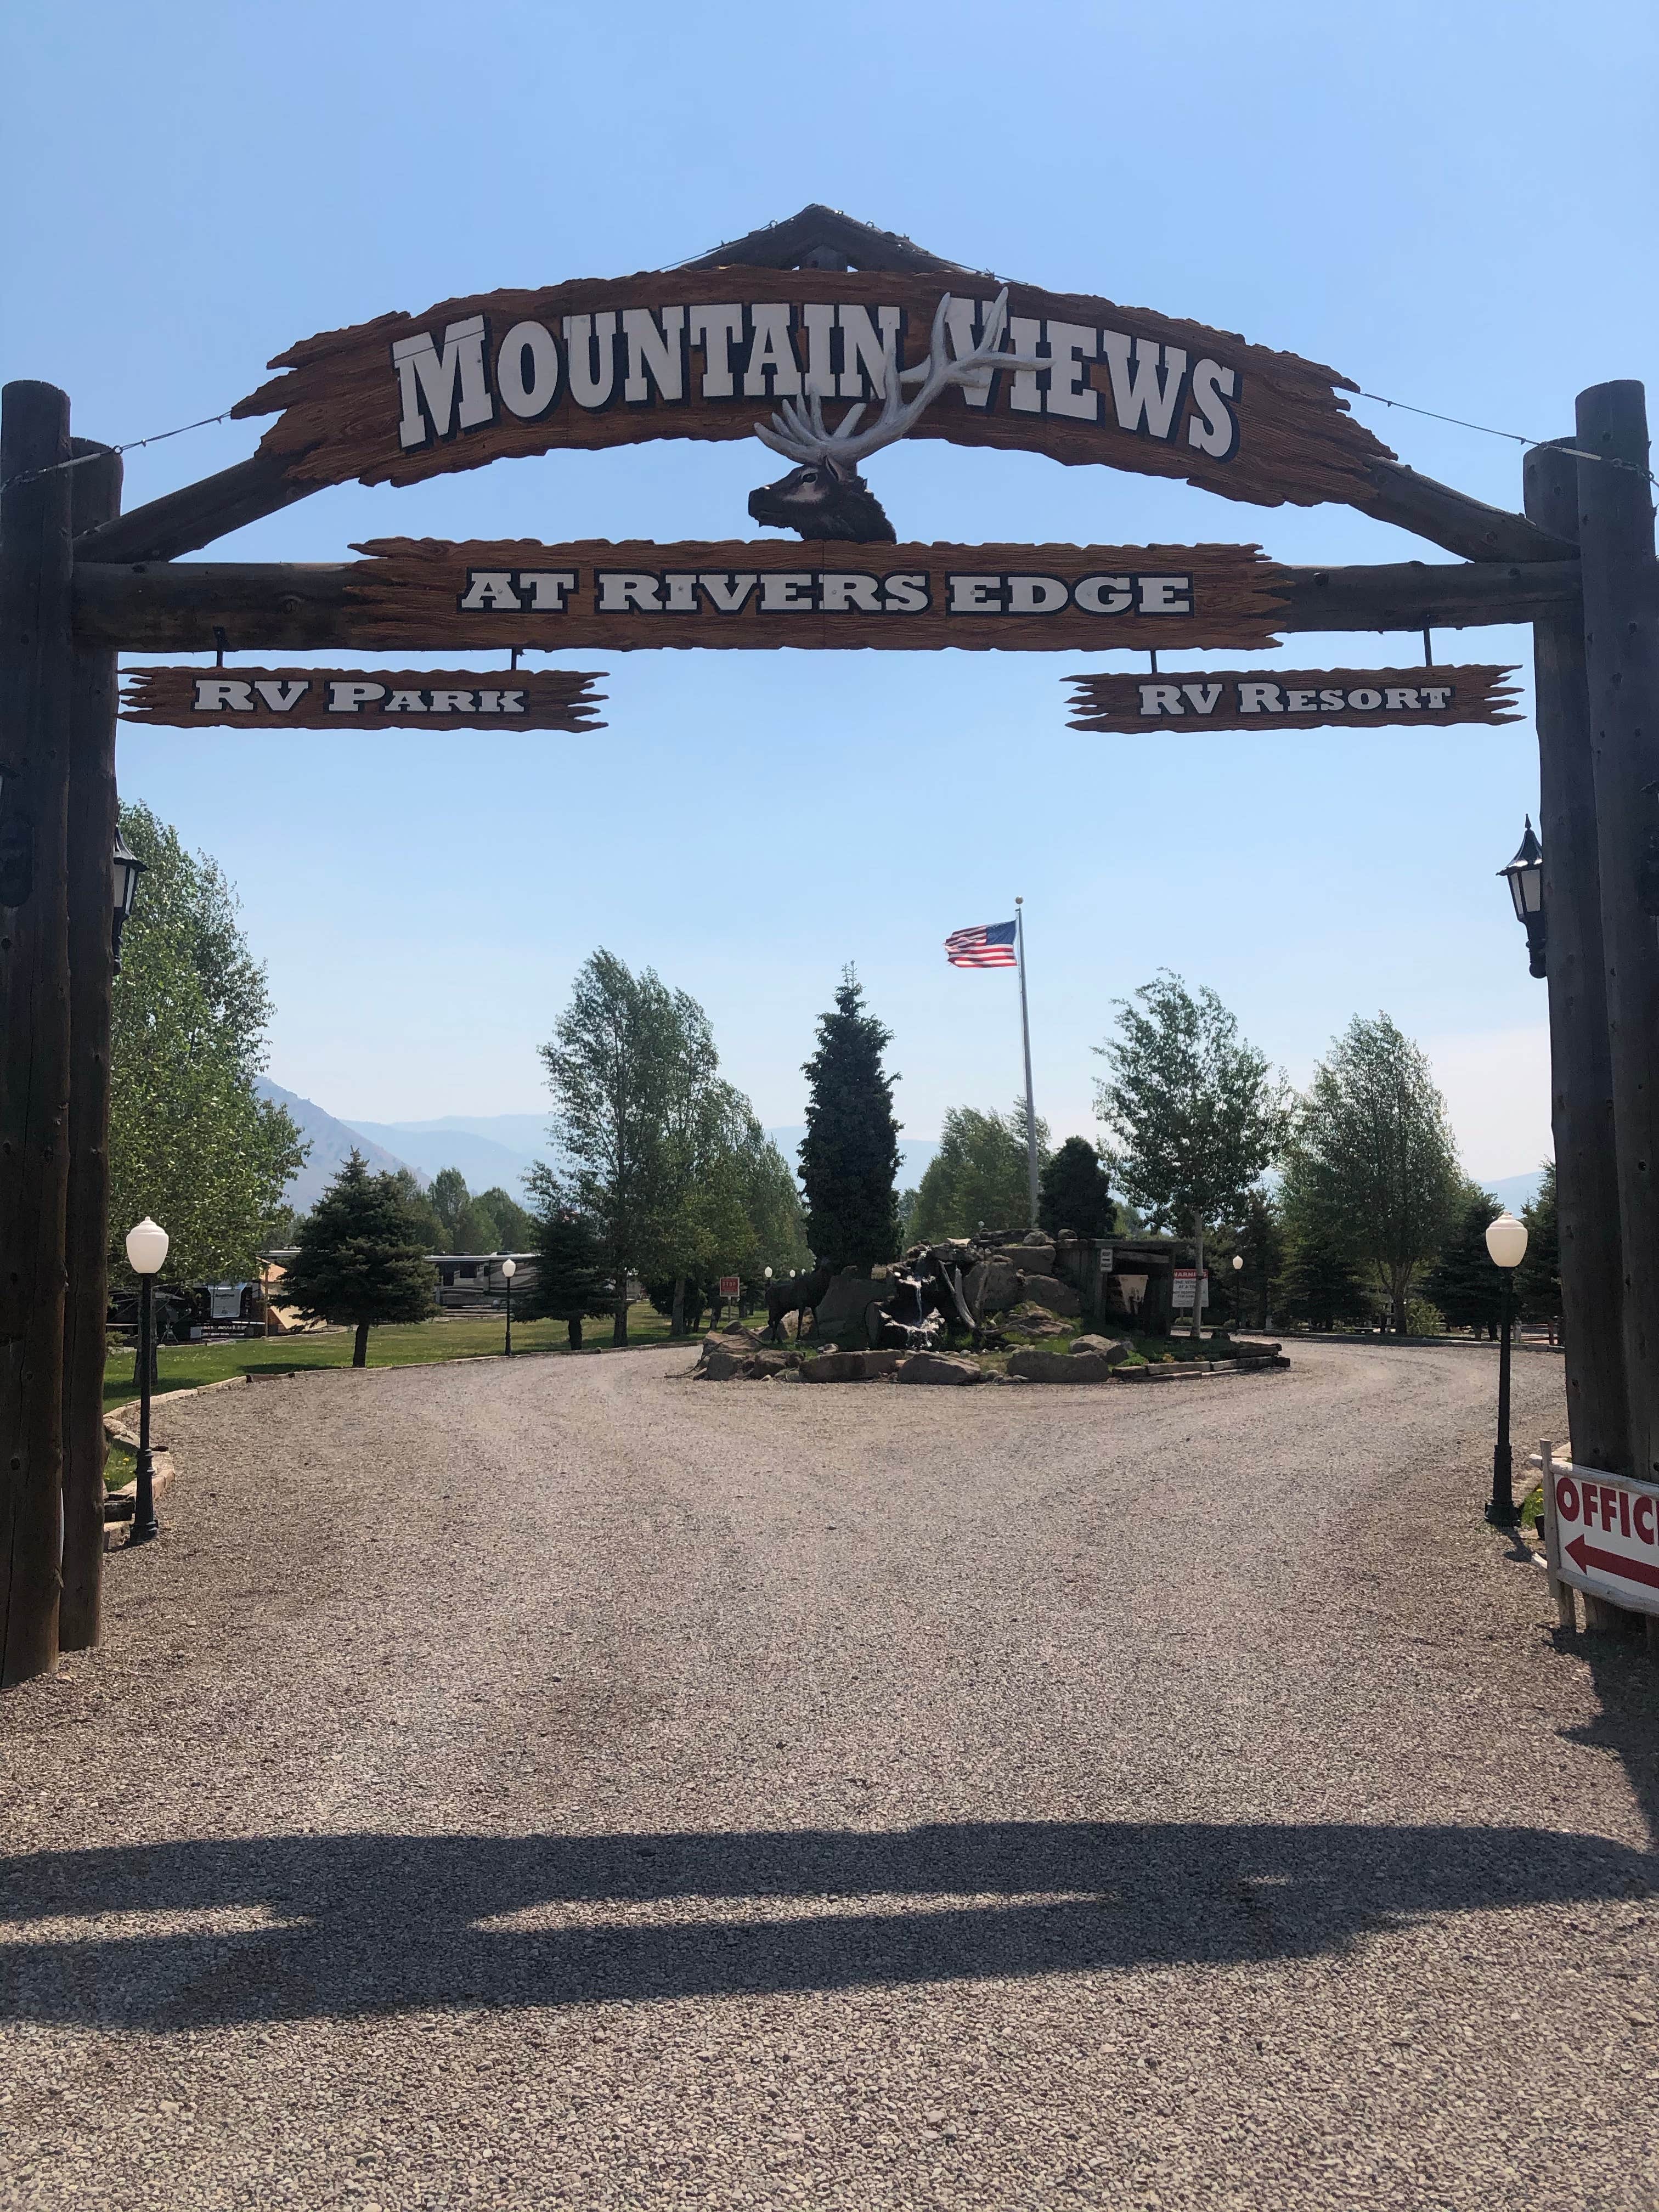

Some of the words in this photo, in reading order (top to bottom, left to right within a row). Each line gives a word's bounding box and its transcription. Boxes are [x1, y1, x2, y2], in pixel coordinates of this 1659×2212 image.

[392, 303, 901, 449] MOUNTAIN
[945, 297, 1235, 457] VIEWS
[462, 572, 574, 610] AT
[599, 572, 928, 612] RIVERS
[949, 575, 1190, 612] EDGE
[194, 680, 309, 711] RV
[328, 681, 525, 713] PARK
[1139, 684, 1223, 715] RV
[1239, 682, 1451, 713] RESORT
[1556, 1477, 1659, 1547] OFFIC
